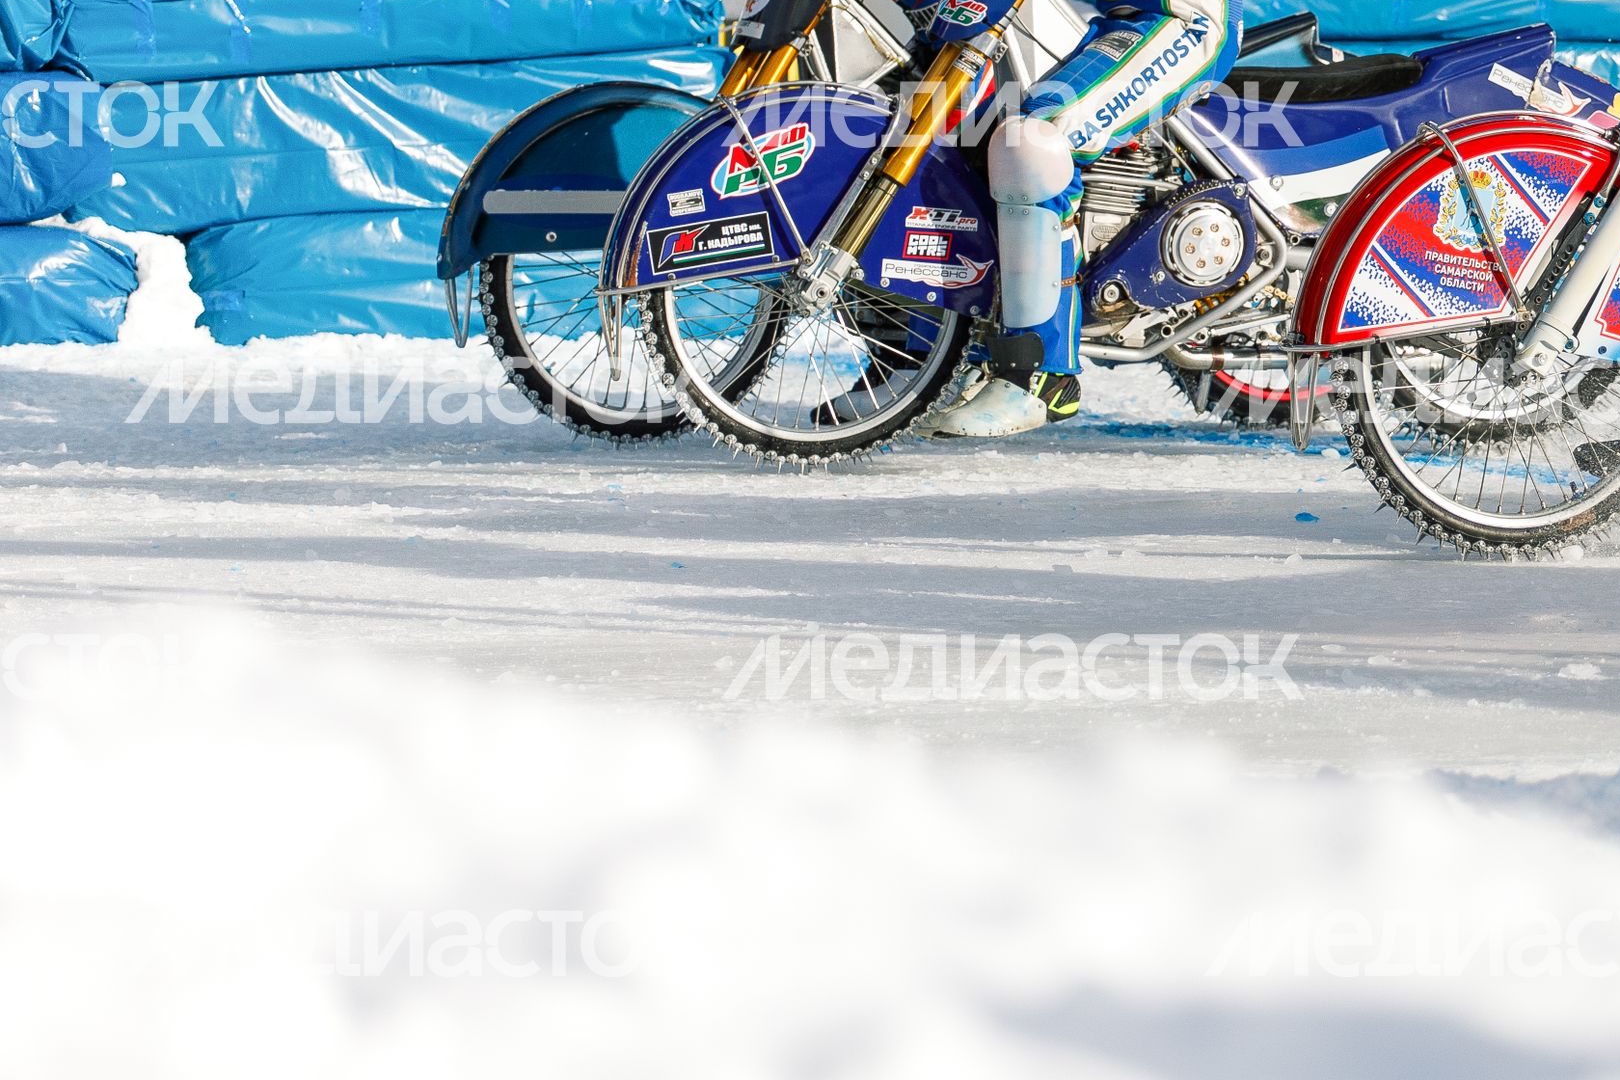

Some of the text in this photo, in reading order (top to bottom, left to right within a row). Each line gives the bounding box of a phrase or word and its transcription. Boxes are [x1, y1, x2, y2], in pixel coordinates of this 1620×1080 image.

[1067, 15, 1210, 150] BASHKORTOSTAN
[721, 223, 749, 236] ЦТВС
[698, 232, 764, 251] Г. КАДЫРОВА
[907, 234, 949, 246] COOL
[906, 245, 948, 257] MTRS
[885, 263, 968, 280] Ренессанс
[1434, 264, 1493, 282] САМАРСКОЙ
[1440, 277, 1485, 293] ОБЛАСТИ
